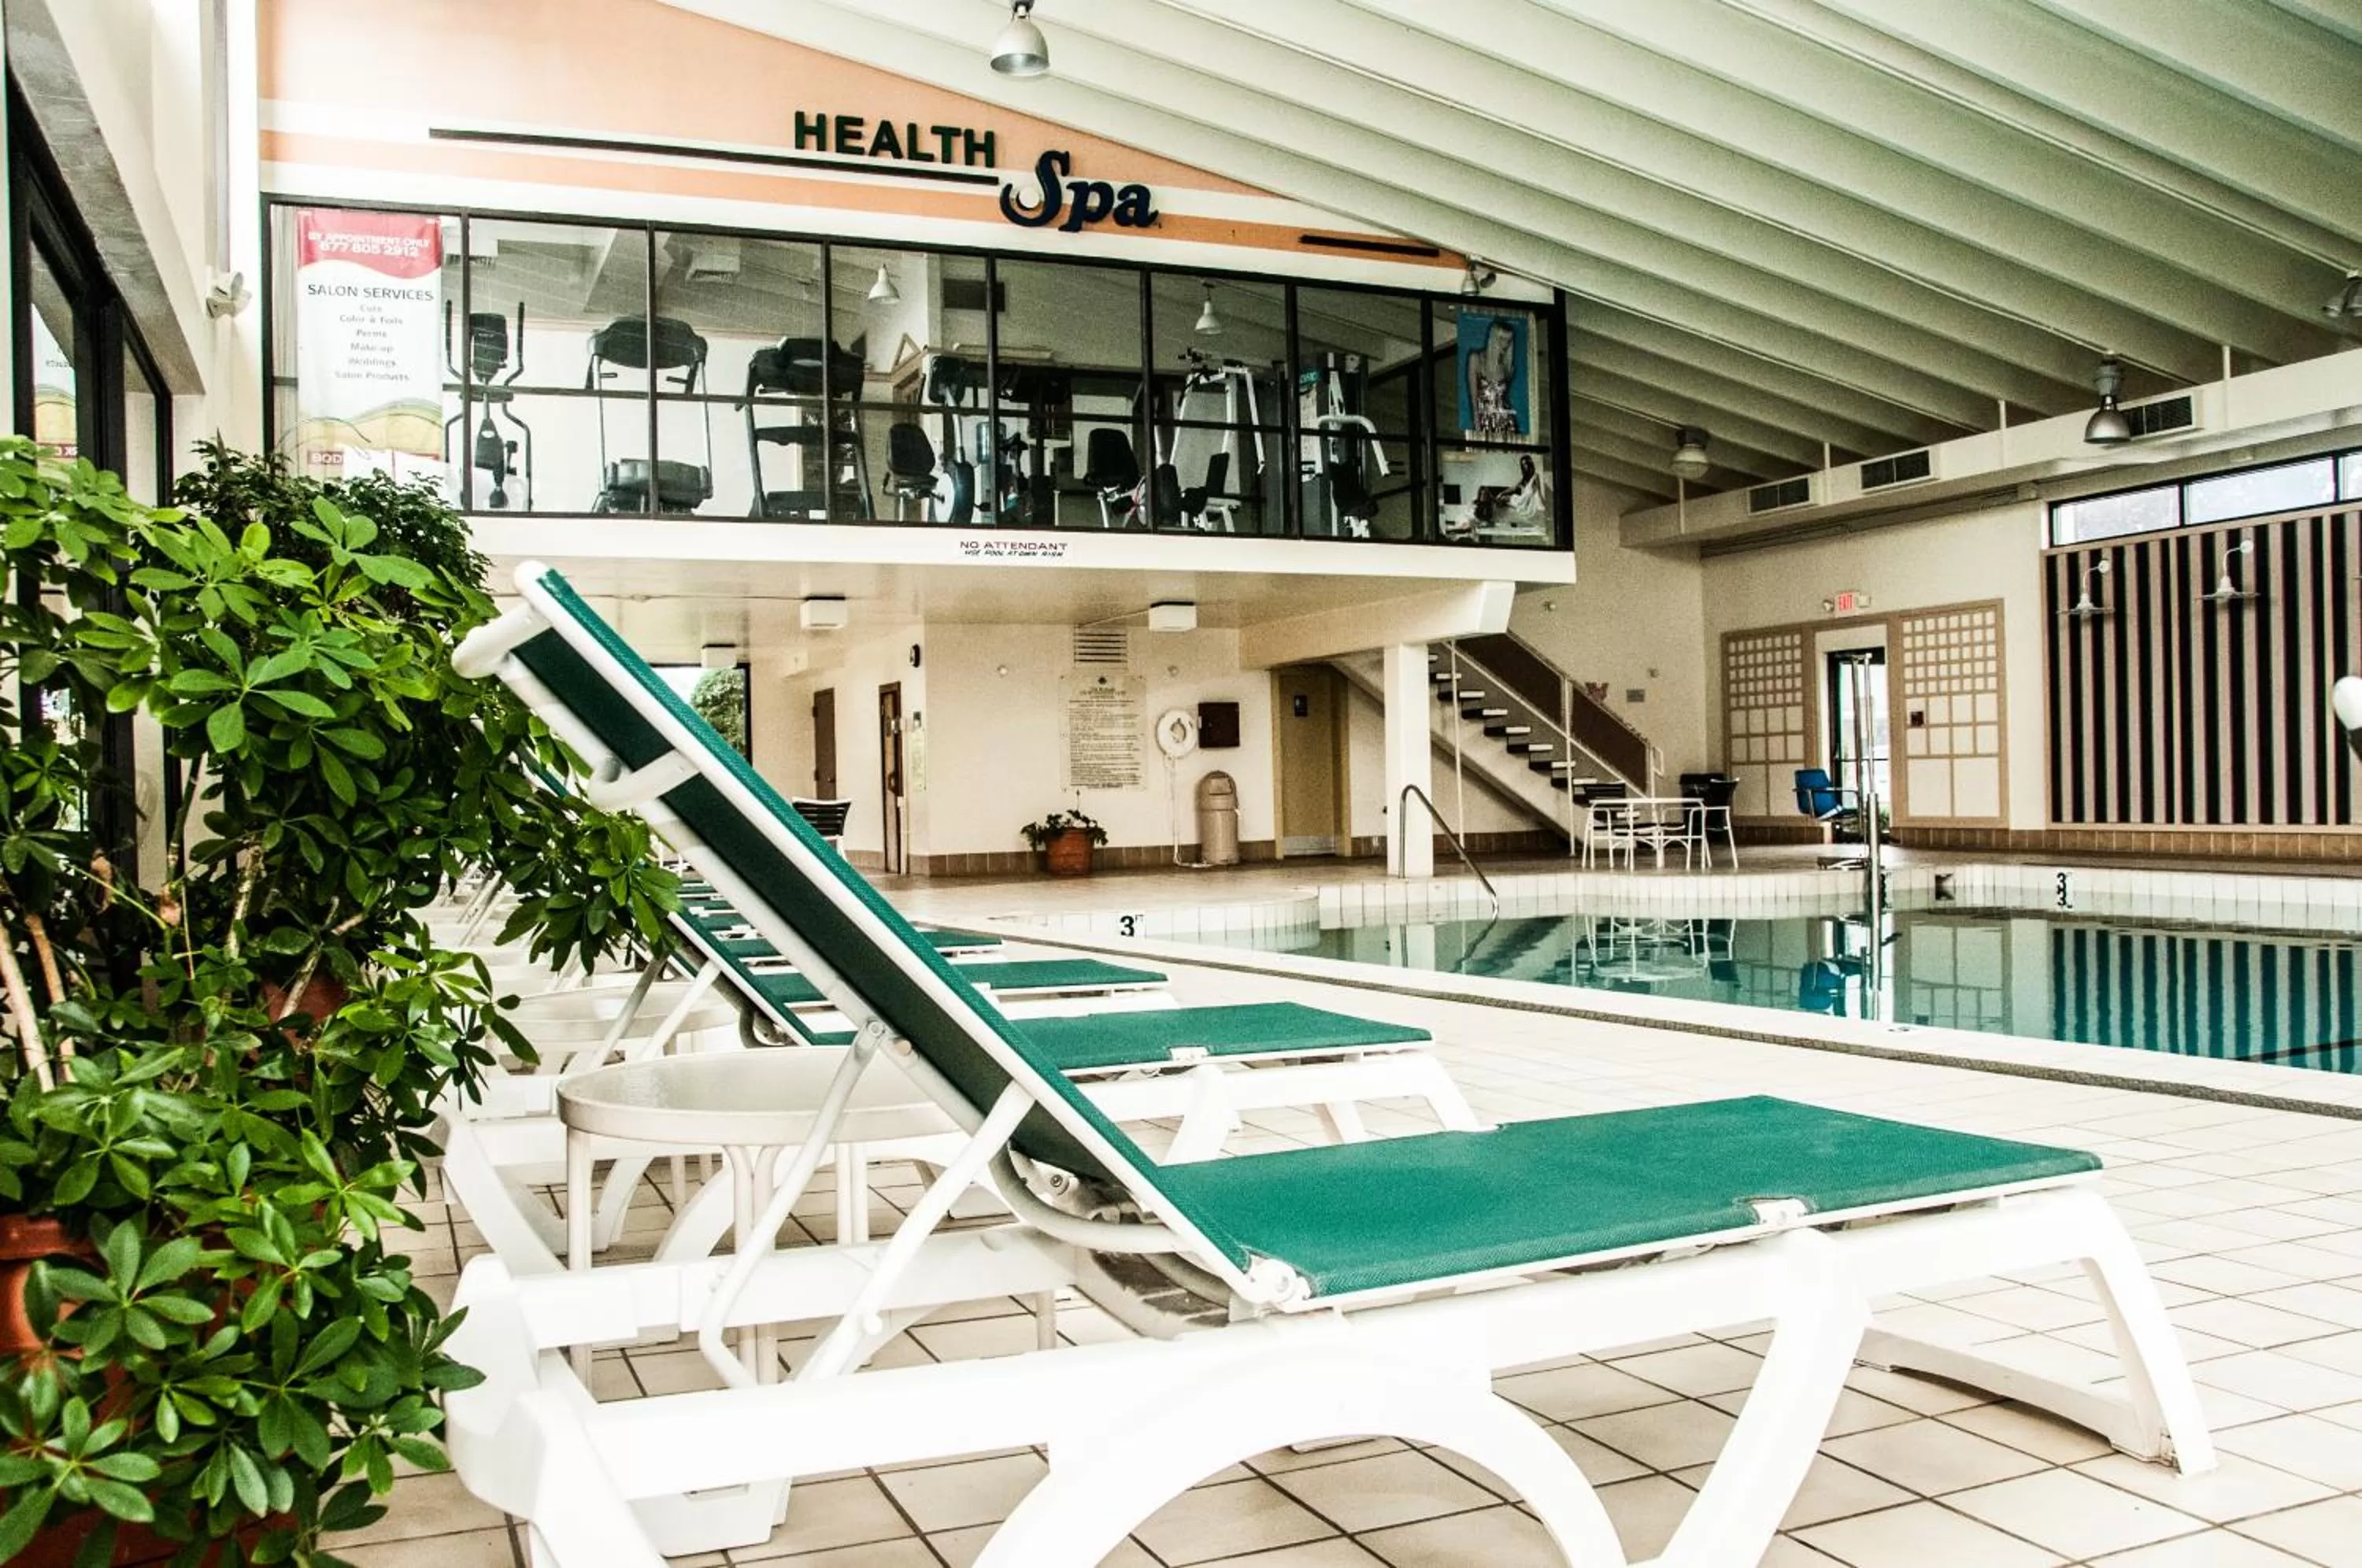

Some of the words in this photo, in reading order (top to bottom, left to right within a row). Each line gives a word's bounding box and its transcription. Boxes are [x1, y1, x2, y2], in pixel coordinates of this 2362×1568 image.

[794, 111, 995, 168] HEALTH
[1000, 150, 1161, 232] Spa
[307, 283, 358, 298] SALON
[363, 287, 435, 301] SERVICES
[983, 541, 1068, 550] ATTENDANT
[1839, 595, 1852, 611] EXIT
